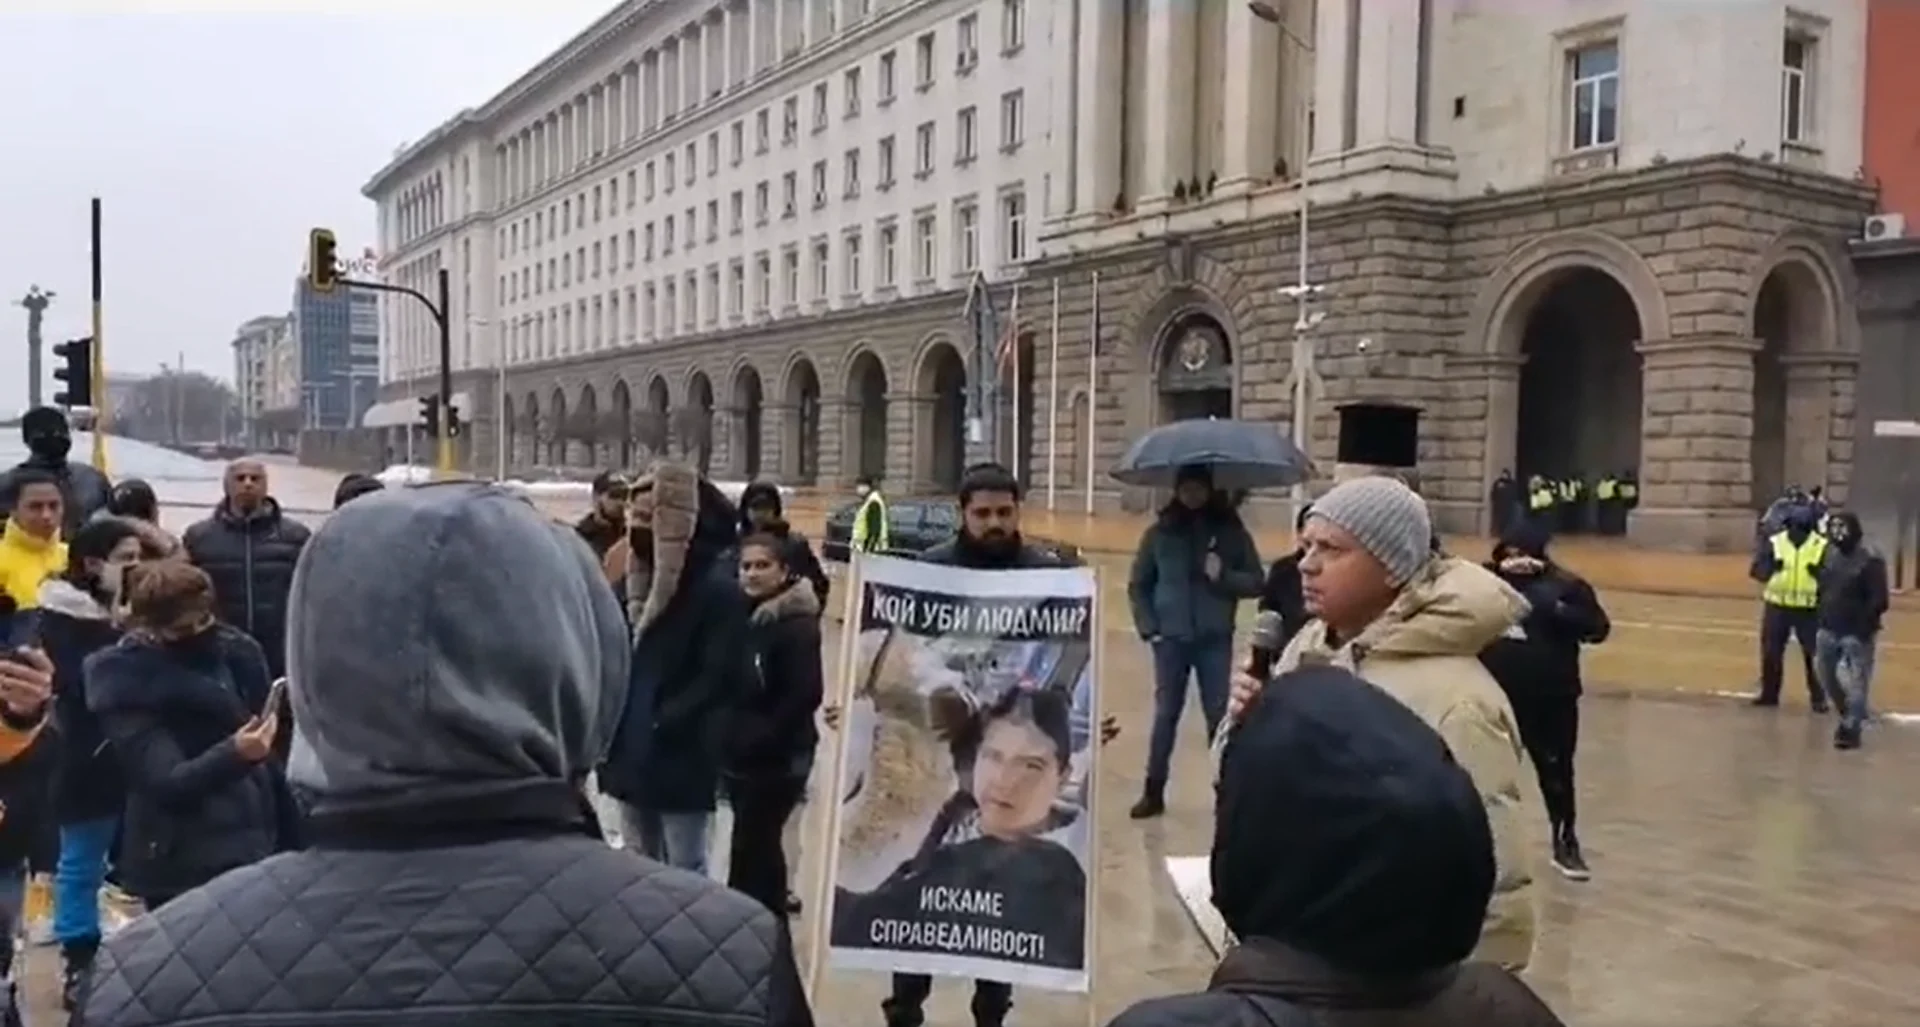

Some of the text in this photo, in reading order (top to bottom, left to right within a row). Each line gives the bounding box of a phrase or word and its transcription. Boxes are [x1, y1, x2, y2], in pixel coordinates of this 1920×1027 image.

[871, 590, 916, 627] КОЙ
[921, 602, 969, 632] УБИ
[919, 885, 1003, 917] ИСКАМЕ
[870, 918, 1045, 959] СПРАВЕДЛИВОСТ!
